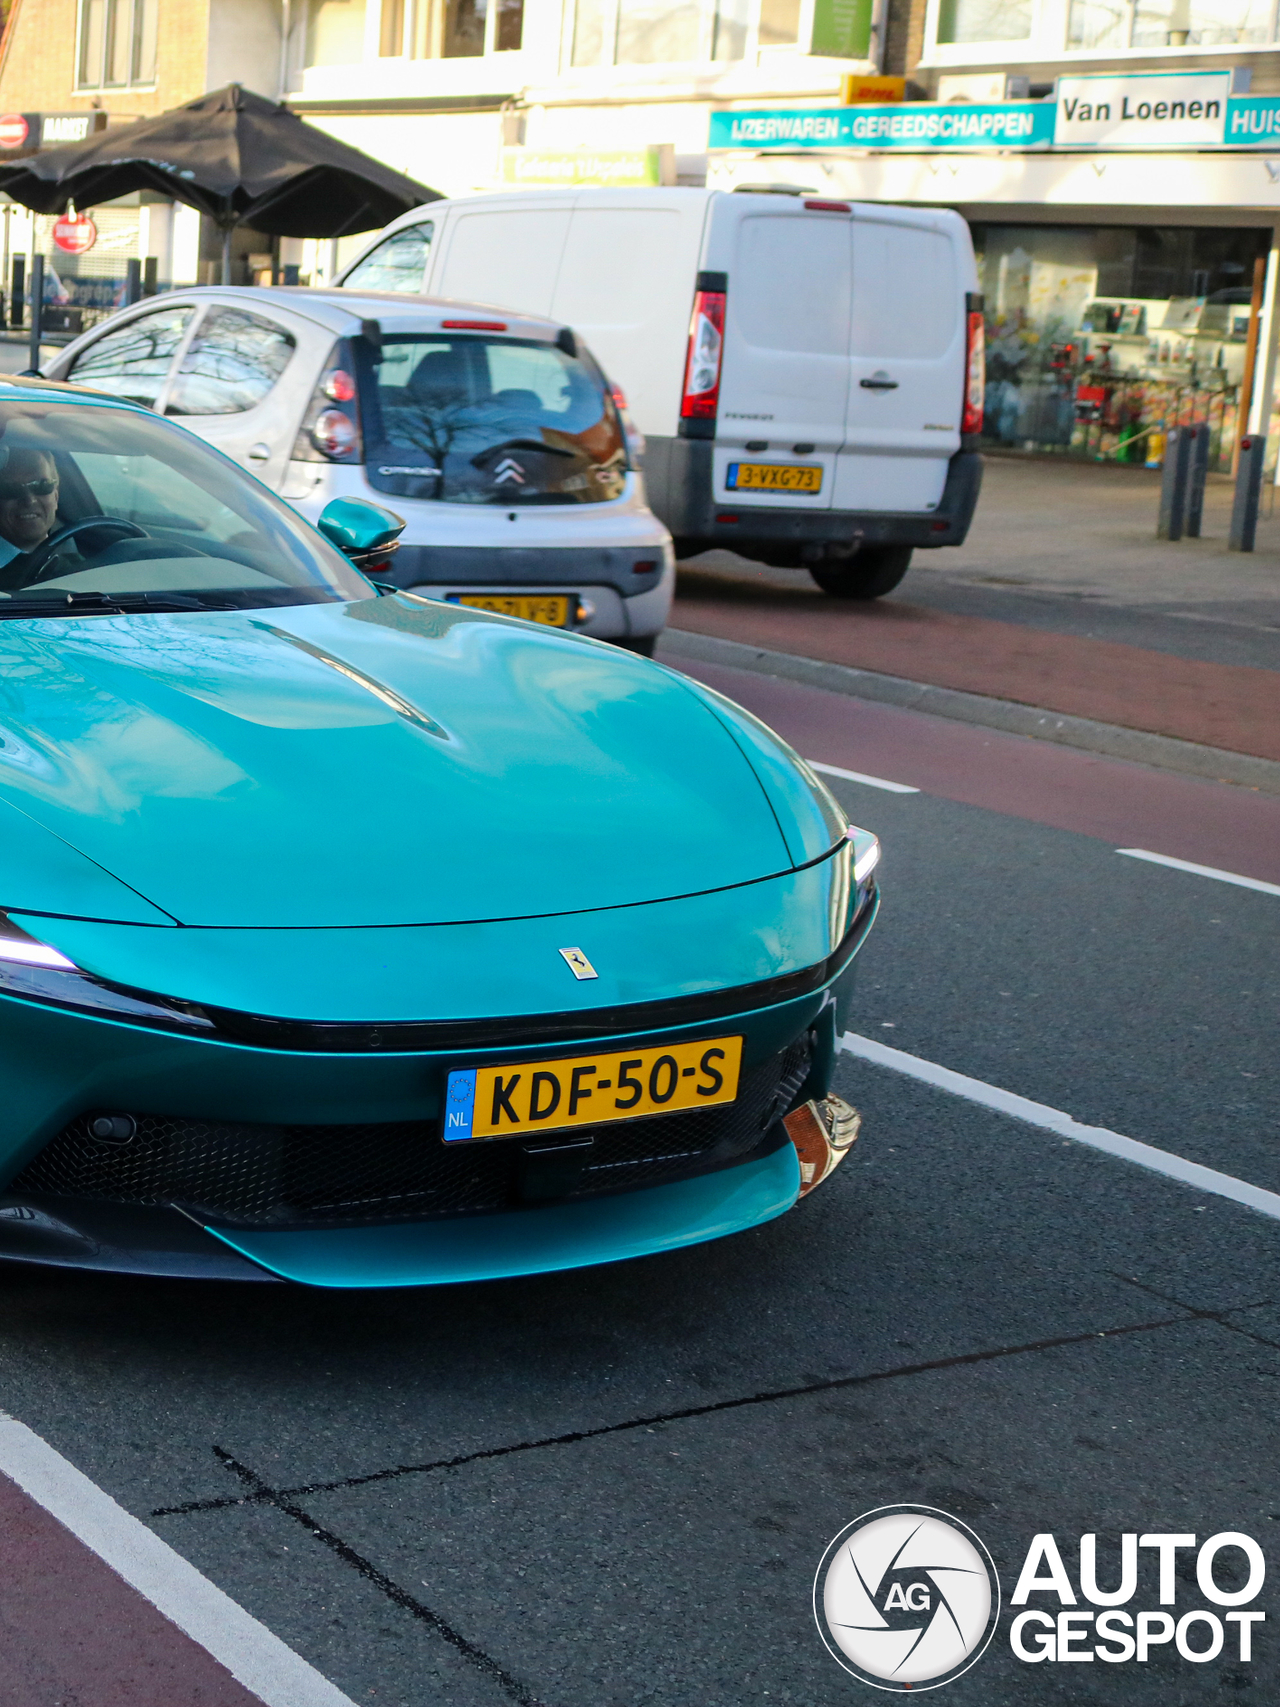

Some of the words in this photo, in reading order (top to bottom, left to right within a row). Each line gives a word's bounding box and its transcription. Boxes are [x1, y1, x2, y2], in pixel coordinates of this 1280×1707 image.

[1063, 97, 1110, 121] Van
[1121, 95, 1220, 120] Loenen
[43, 117, 89, 142] MARKET
[731, 116, 839, 140] IJZERWAREN
[852, 113, 1035, 138] GEREEDSCHAPPEN
[743, 467, 814, 487] 3-VXG-73
[448, 1111, 469, 1128] NL
[490, 1047, 726, 1126] KDF-50-S
